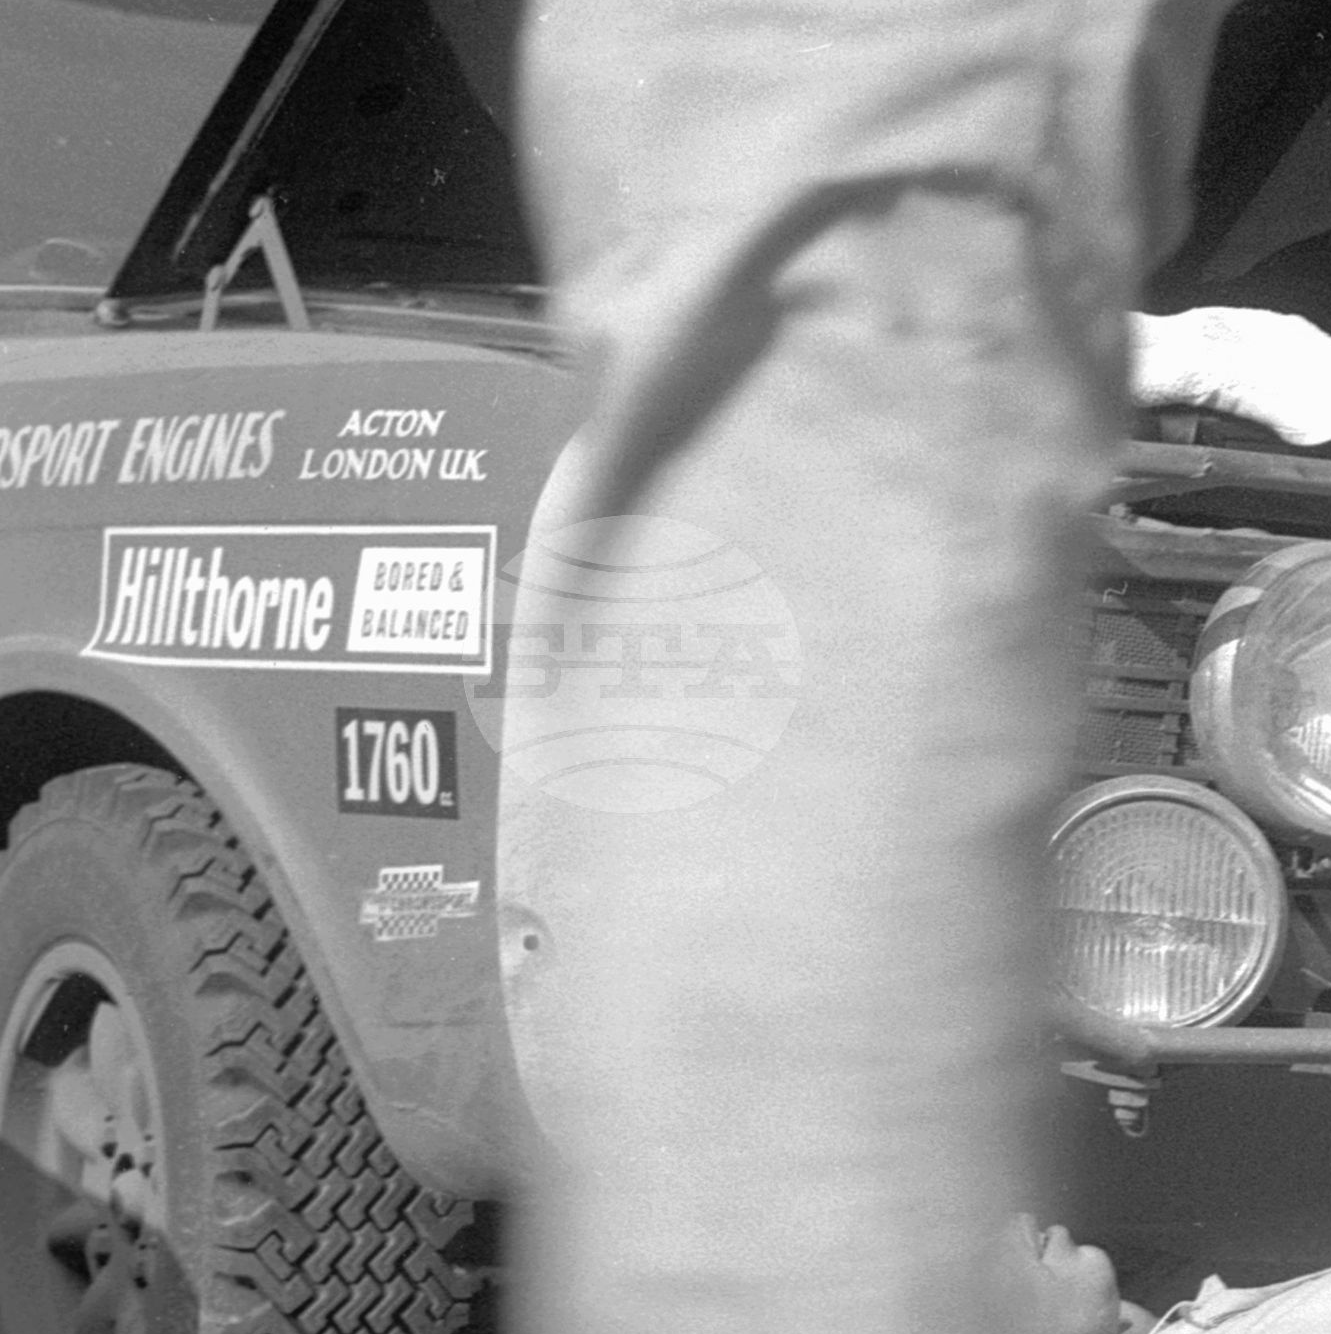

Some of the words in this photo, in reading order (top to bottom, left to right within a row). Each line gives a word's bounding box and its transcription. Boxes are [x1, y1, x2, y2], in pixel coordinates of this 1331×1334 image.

[337, 409, 447, 438] ACTON
[117, 409, 286, 484] ENGINES
[299, 448, 435, 481] LONDON
[438, 448, 489, 481] UK
[372, 561, 444, 592] BORED
[448, 560, 465, 592] &
[104, 546, 335, 652] Hillthorne
[360, 608, 469, 641] BALANCED
[342, 719, 440, 805] 1760
